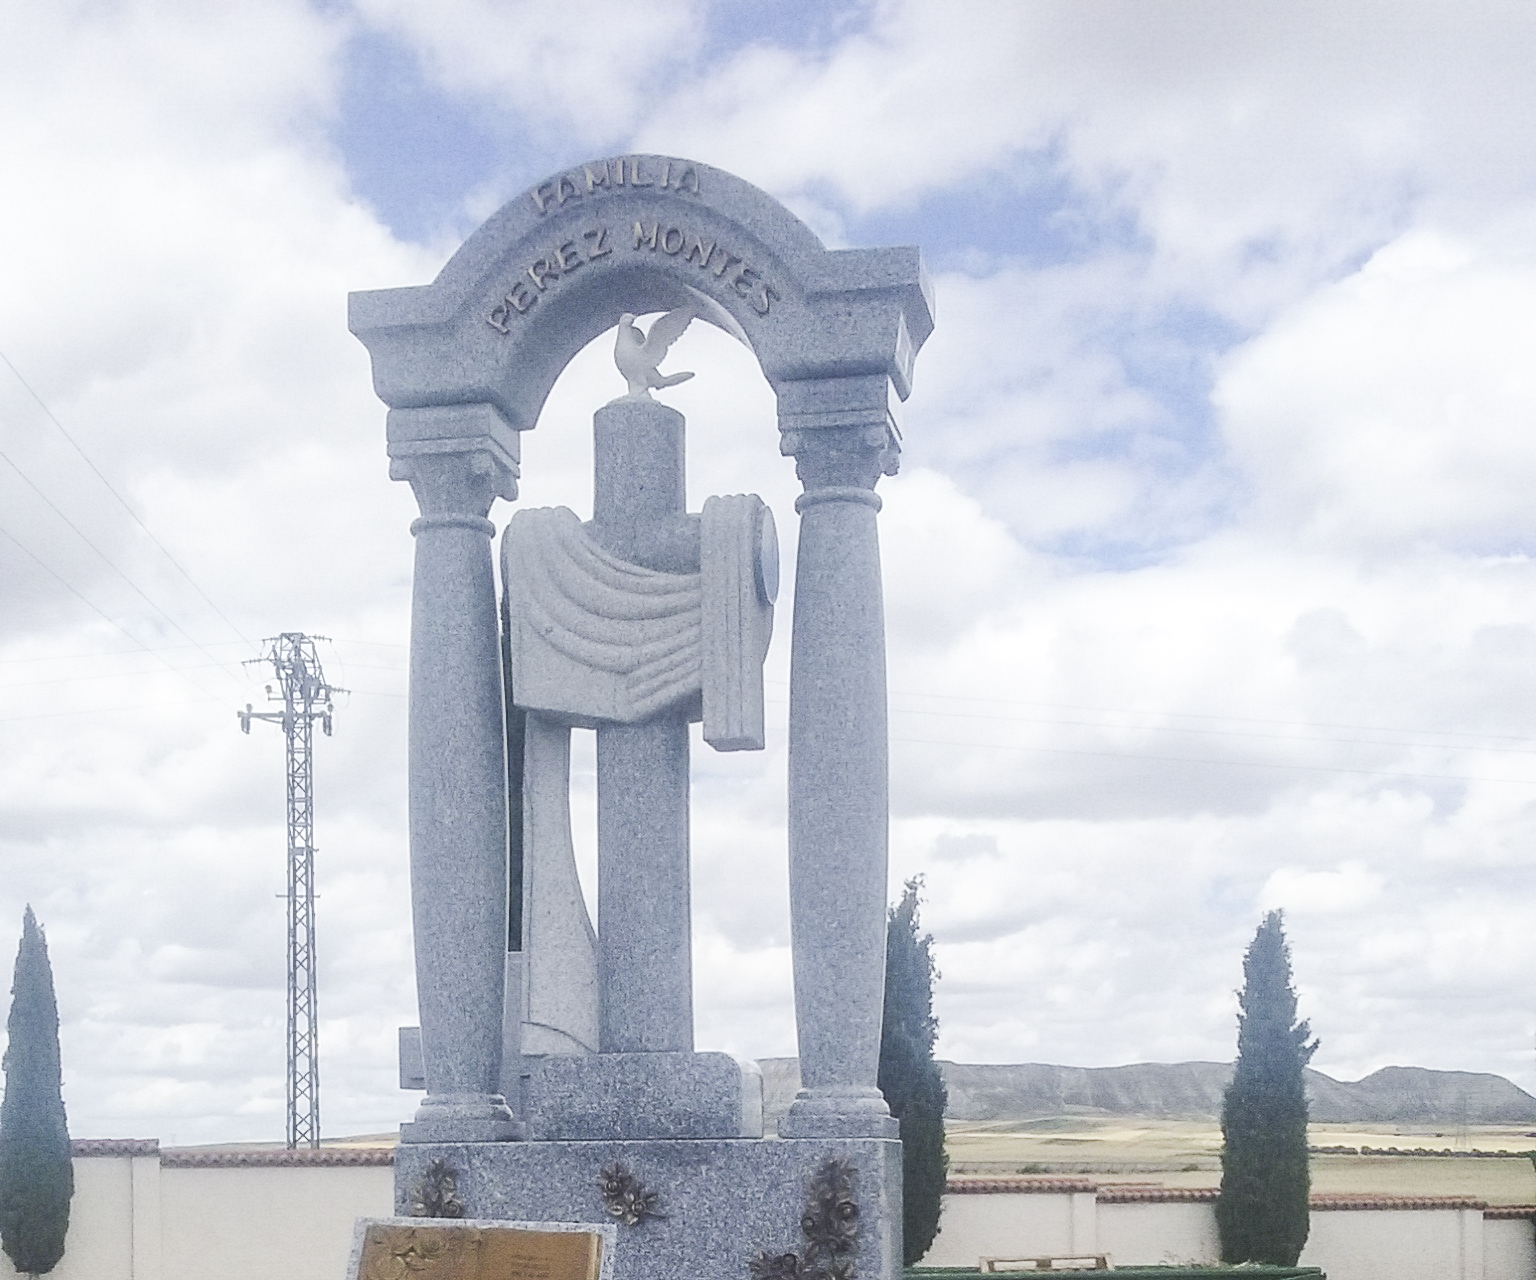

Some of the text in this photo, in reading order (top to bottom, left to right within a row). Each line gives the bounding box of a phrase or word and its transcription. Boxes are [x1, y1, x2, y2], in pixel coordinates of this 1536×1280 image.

[529, 159, 700, 217] FAMILIA
[485, 220, 780, 335] PEREZ MONTES
